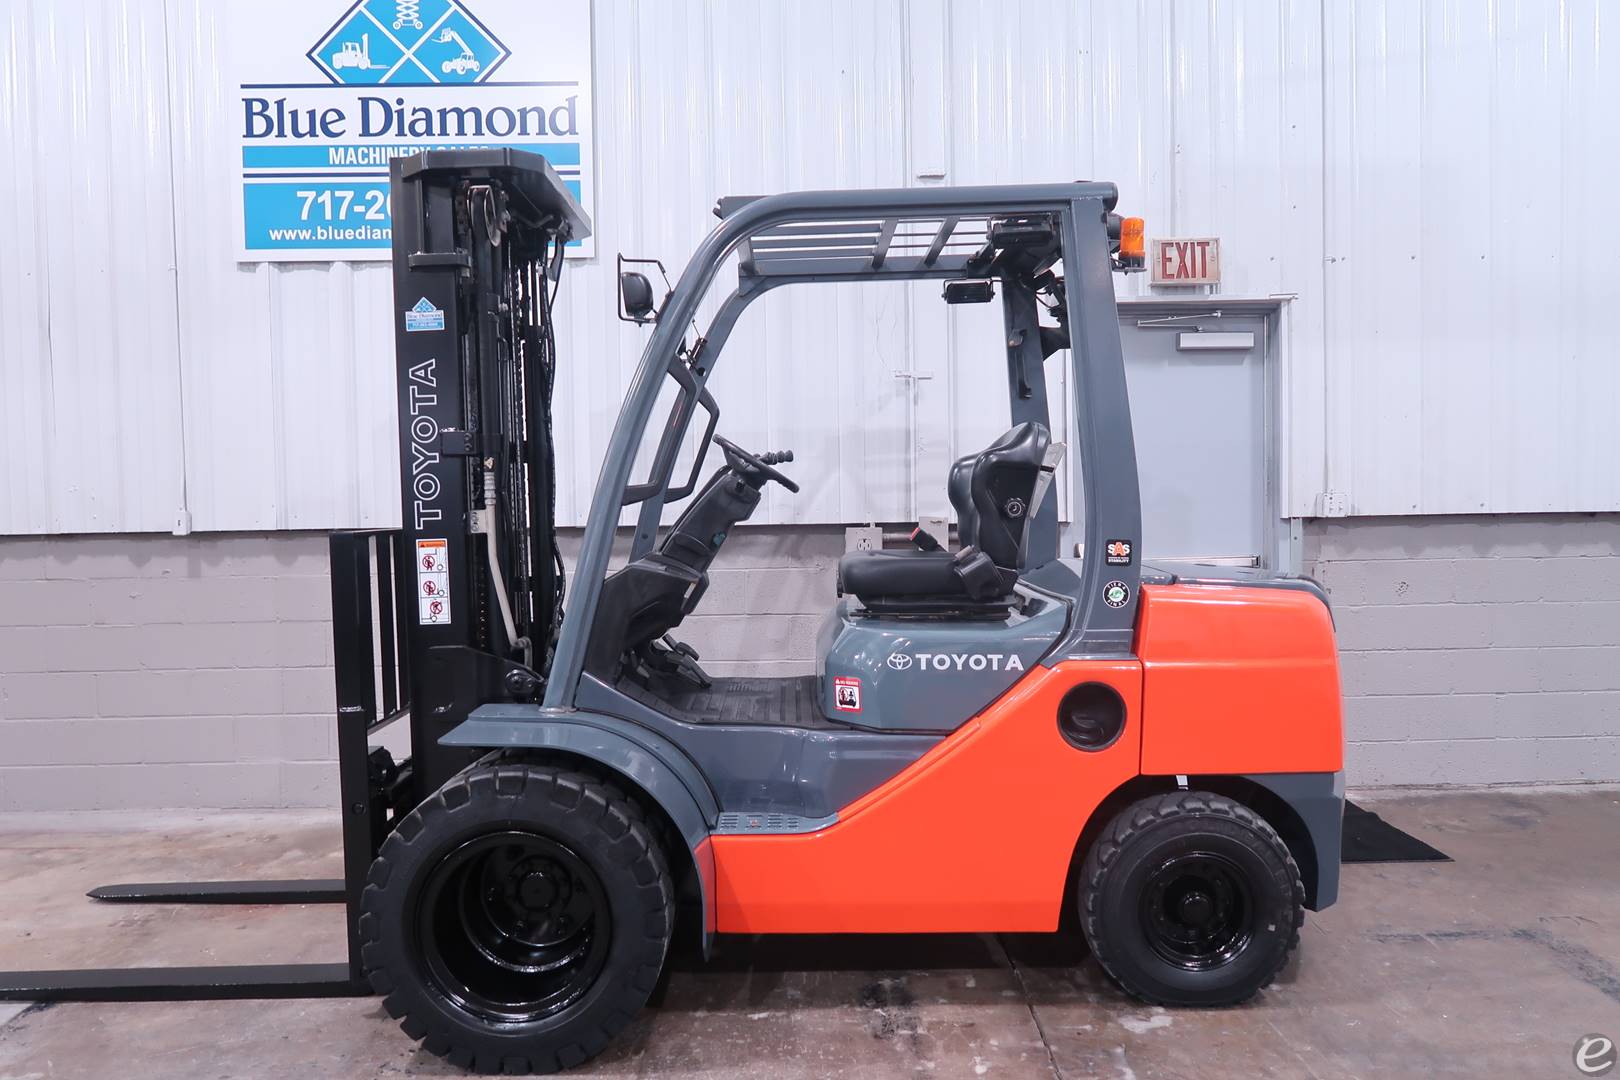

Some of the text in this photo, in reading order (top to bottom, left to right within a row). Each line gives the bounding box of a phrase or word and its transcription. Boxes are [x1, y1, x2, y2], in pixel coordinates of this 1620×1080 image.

[241, 95, 579, 138] Blue Diamond
[329, 146, 431, 165] MACHINE
[296, 190, 392, 221] 717-2
[1161, 242, 1209, 279] EXIT
[409, 358, 442, 529] TOYOTA
[1107, 541, 1130, 556] SAS
[915, 653, 1024, 671] TOYOTA
